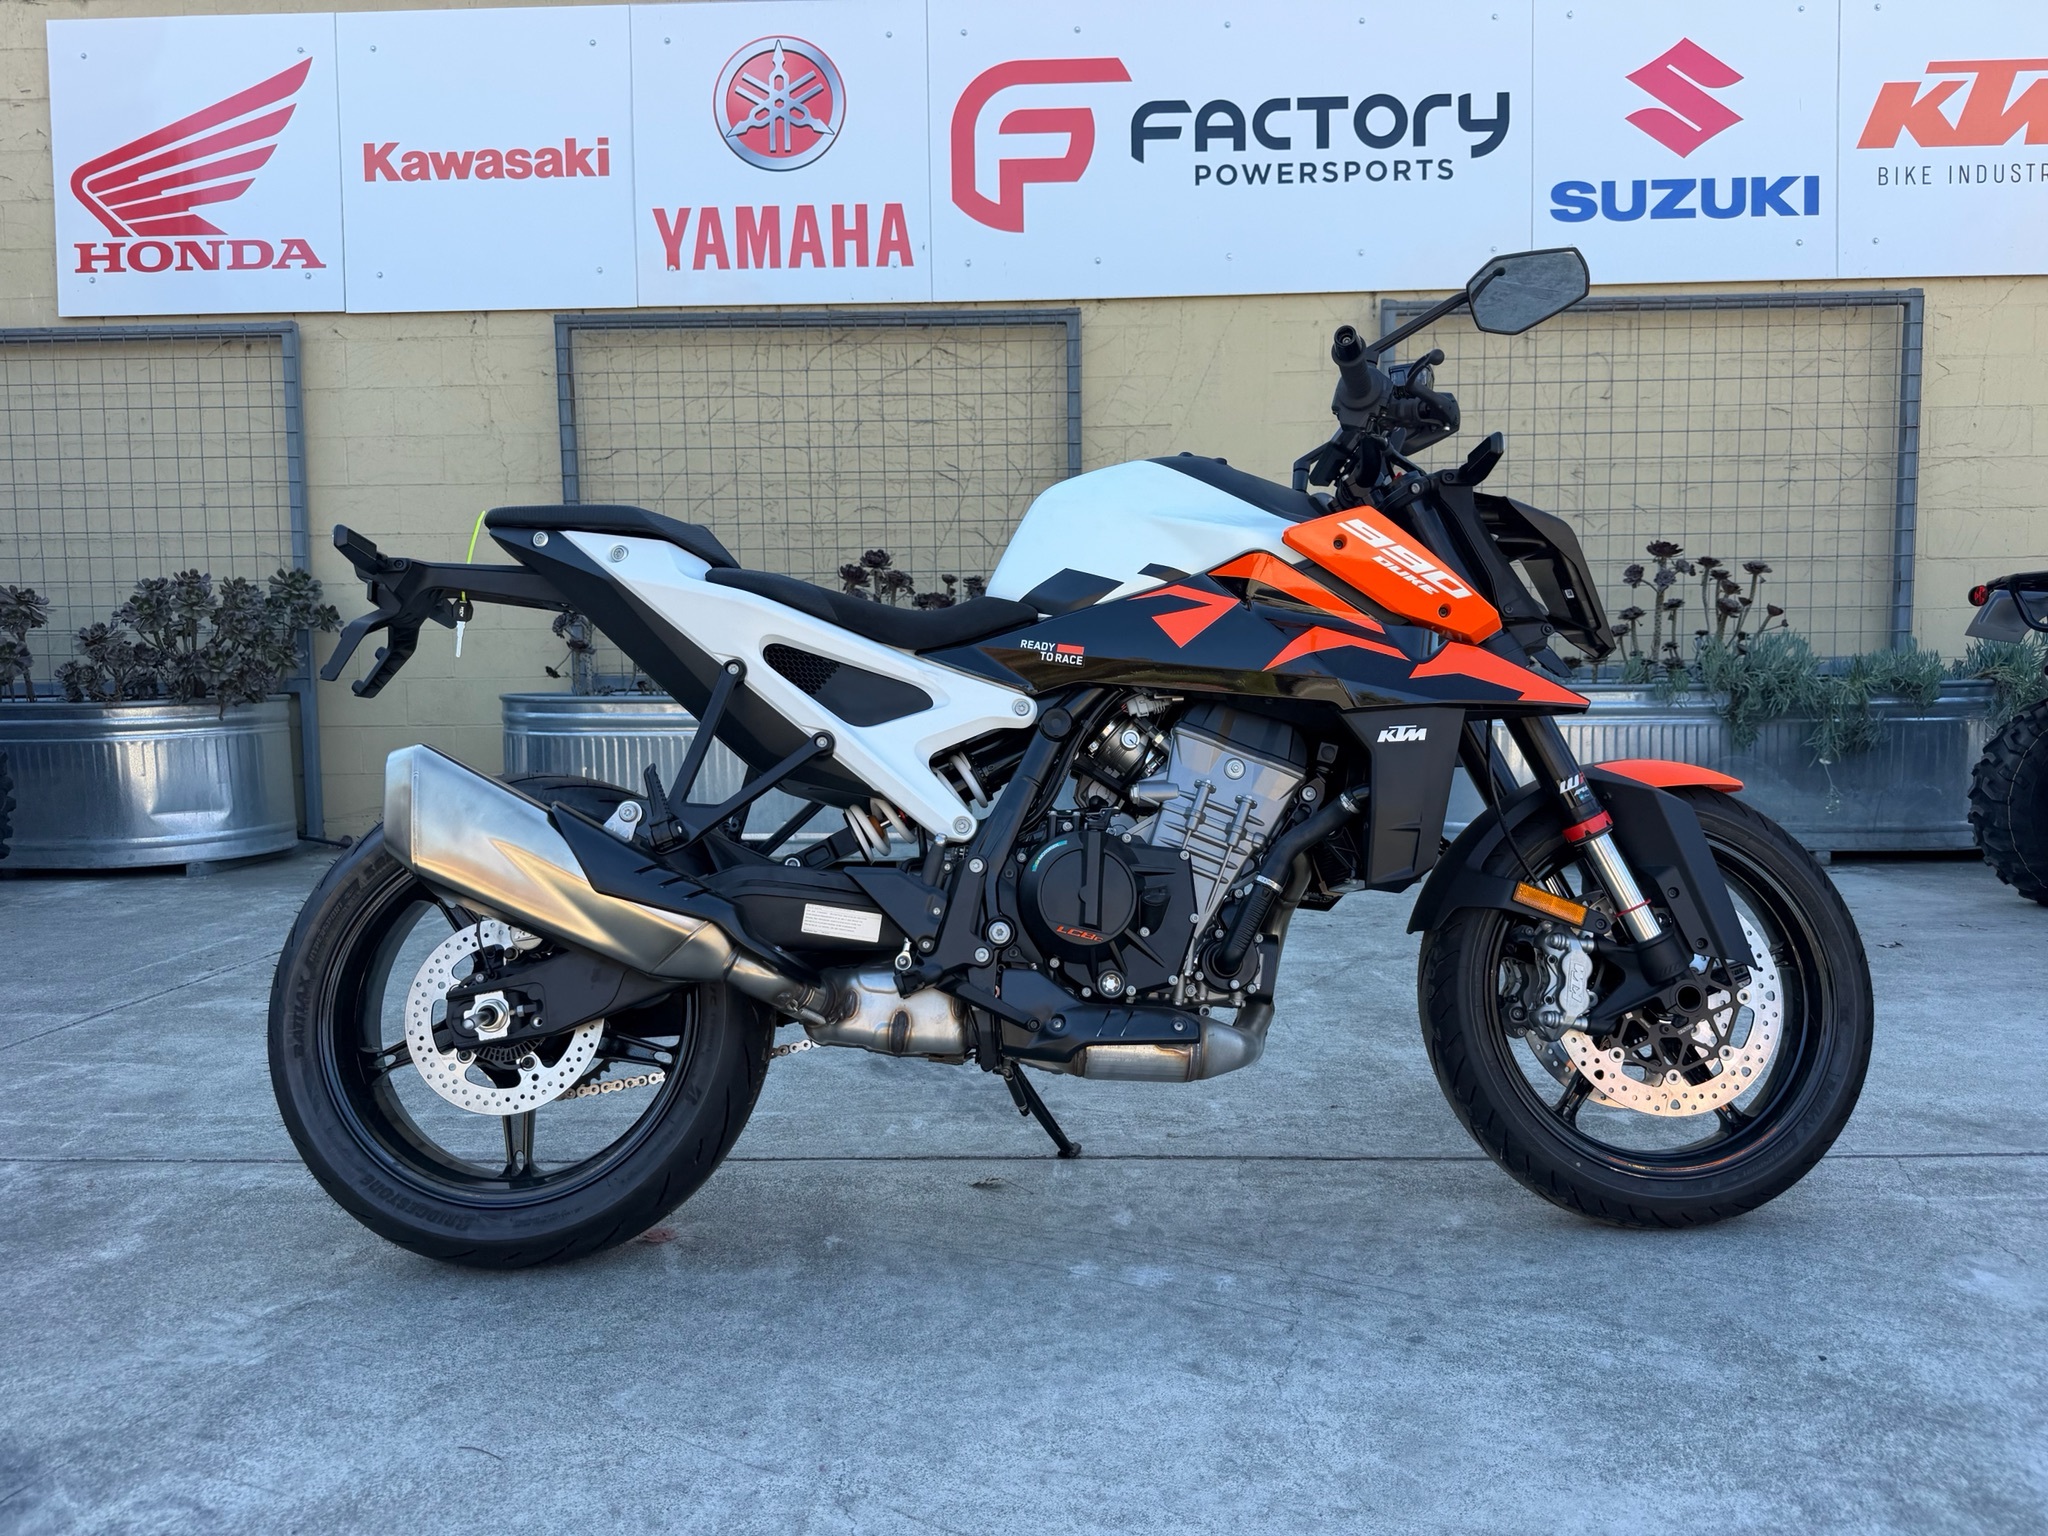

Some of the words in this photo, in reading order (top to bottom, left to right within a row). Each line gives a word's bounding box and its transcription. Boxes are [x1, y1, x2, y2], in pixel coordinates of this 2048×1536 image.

[364, 137, 610, 183] Kawasaki
[1194, 158, 1454, 187] POWERSPORTS
[1877, 165, 1932, 186] BIKE
[1549, 175, 1820, 222] SUZUKI
[652, 202, 915, 271] YAMAHA
[73, 238, 327, 274] HONDA
[1336, 518, 1473, 599] 990
[1371, 555, 1440, 595] DUKE
[1020, 639, 1055, 651] READY
[1040, 651, 1054, 662] TO
[1055, 653, 1083, 666] RACE
[1376, 724, 1427, 742] KTM
[358, 1172, 478, 1233] BRIDGESTONE
